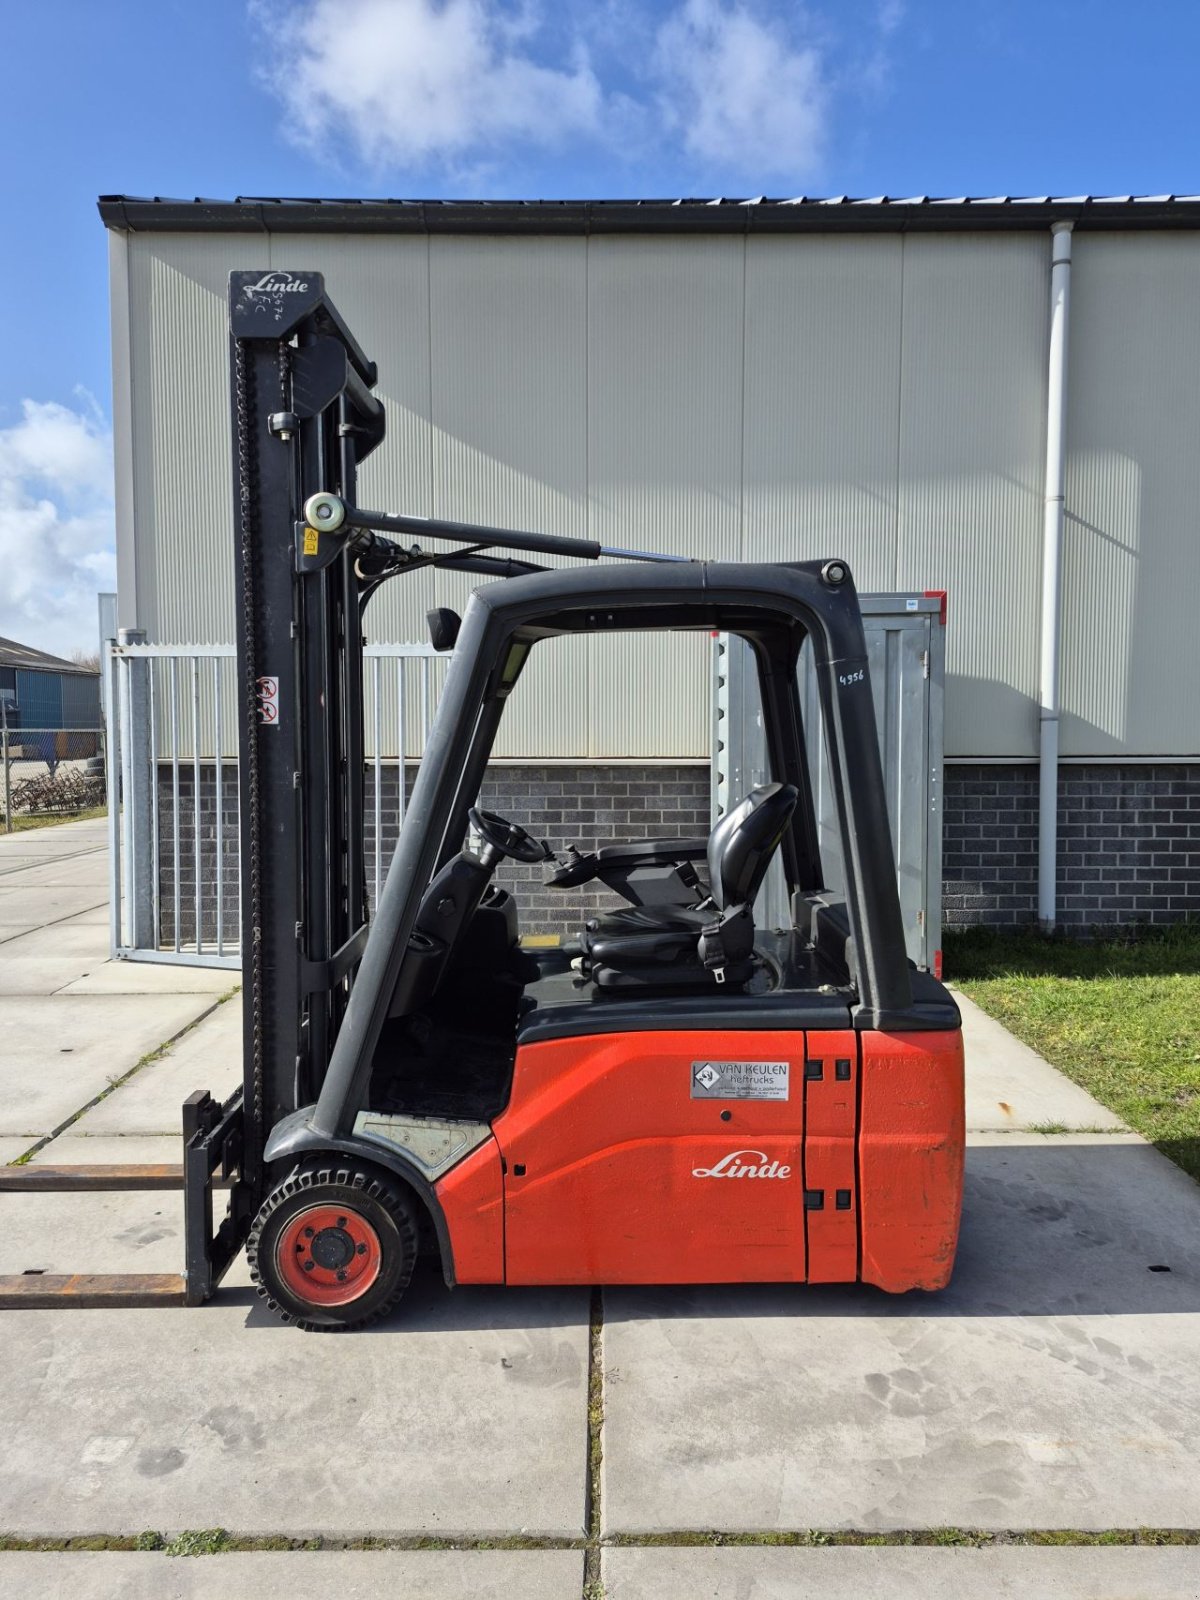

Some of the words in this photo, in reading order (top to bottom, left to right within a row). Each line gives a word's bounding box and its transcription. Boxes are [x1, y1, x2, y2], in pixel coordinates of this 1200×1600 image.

[243, 272, 308, 293] Linde
[839, 669, 864, 686] 4956
[719, 1064, 742, 1074] VAN
[745, 1064, 787, 1075] KEULEN
[730, 1074, 774, 1084] heftrucks
[692, 1149, 791, 1178] Linde
